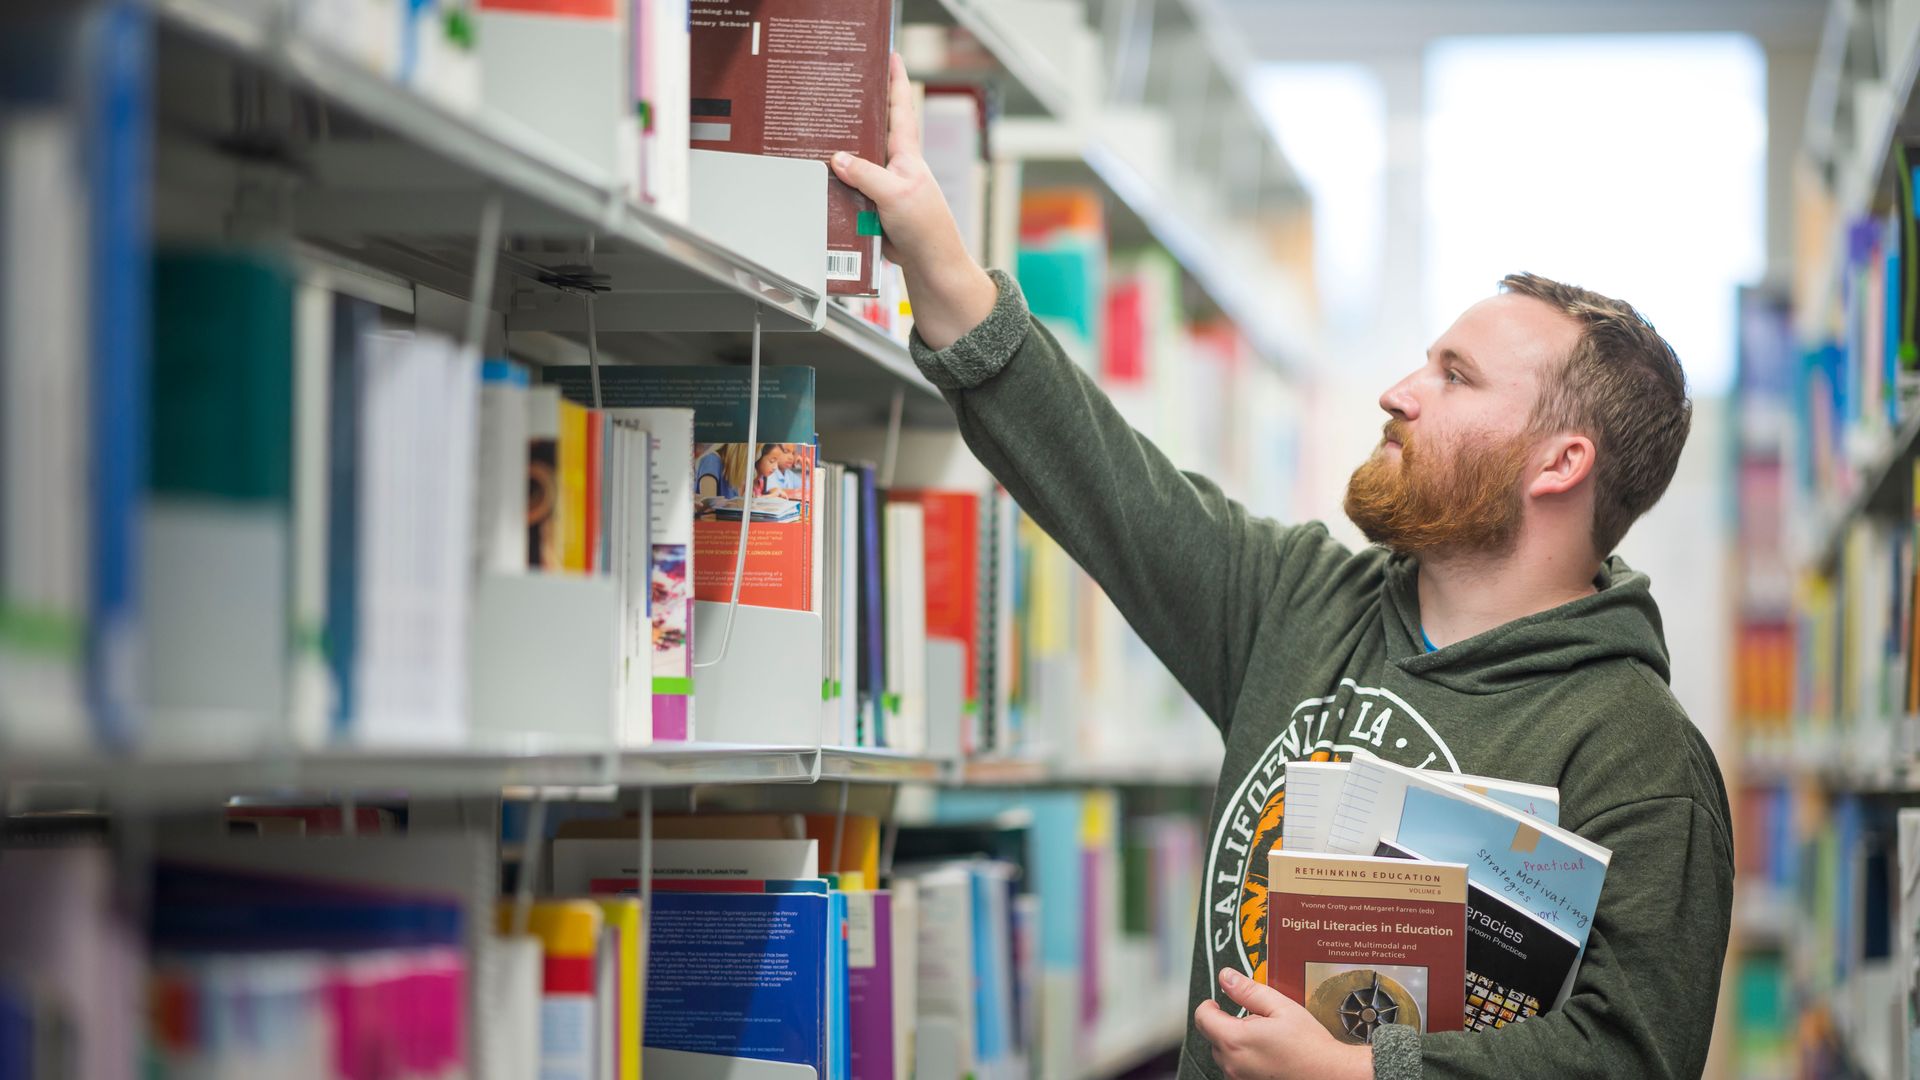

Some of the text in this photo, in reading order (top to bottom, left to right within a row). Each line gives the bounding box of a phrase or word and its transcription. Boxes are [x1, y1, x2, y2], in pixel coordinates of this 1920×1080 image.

[1523, 858, 1585, 872] Practical
[1295, 867, 1441, 883] RETHINKING EDUCATION
[1477, 848, 1532, 903] Strategies
[1409, 887, 1436, 895] VOLUME
[1516, 870, 1590, 929] Motivating
[1327, 903, 1348, 912] Crotty
[1363, 904, 1395, 913] Margaret
[1418, 906, 1435, 915] (eds)
[1282, 917, 1453, 937] Digital Literacies in Education
[1317, 939, 1352, 948] Creative,
[1354, 940, 1400, 950] Multimodal
[1493, 936, 1527, 960] Practices
[1328, 949, 1406, 959] Innovative Practices
